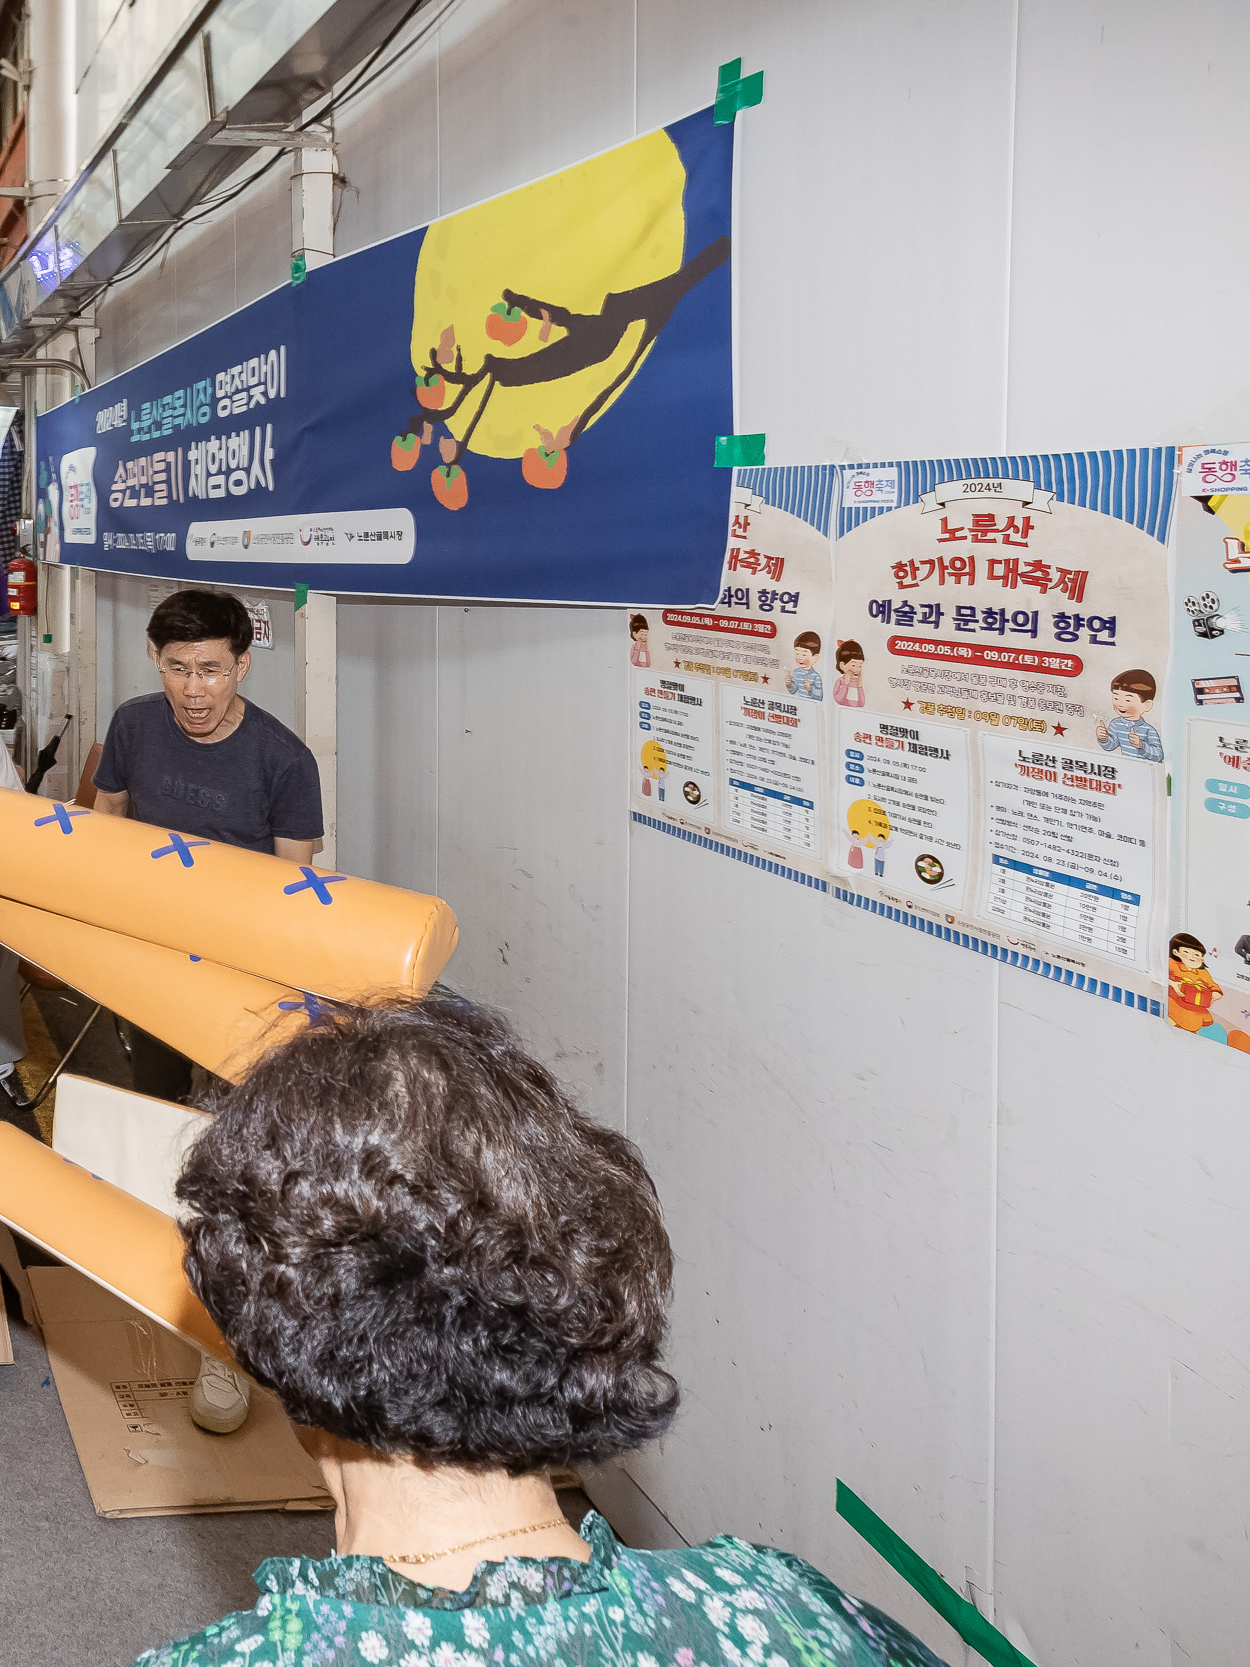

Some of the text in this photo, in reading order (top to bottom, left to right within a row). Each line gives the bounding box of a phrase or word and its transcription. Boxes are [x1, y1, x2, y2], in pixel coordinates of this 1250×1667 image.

[96, 344, 287, 443] 2024년 노룬산골목시장 명절맞이
[109, 423, 276, 508] 송편만들기 체험행사
[852, 478, 896, 497] 동행축제
[962, 481, 1003, 494] 2024년
[356, 530, 403, 542] 노룬산골목시장
[936, 513, 1035, 548] 노룬산
[890, 555, 1089, 603] 한가위 대축제
[757, 588, 800, 615] 향연
[867, 598, 1118, 647] 예술과 문화의 향연
[984, 650, 1039, 667] 09.07.(토)
[1041, 656, 1075, 672] 3일간
[743, 695, 798, 716] 노룬산 골목시장
[937, 701, 965, 721] 추첨일
[974, 708, 1000, 727] 09월
[1002, 714, 1047, 734] 07일(토)
[854, 731, 952, 761] 송편 만들기 체험행사
[879, 723, 920, 741] 명절맞이
[1018, 750, 1118, 780] 노룬산 골목시장
[1217, 801, 1237, 813] 구성
